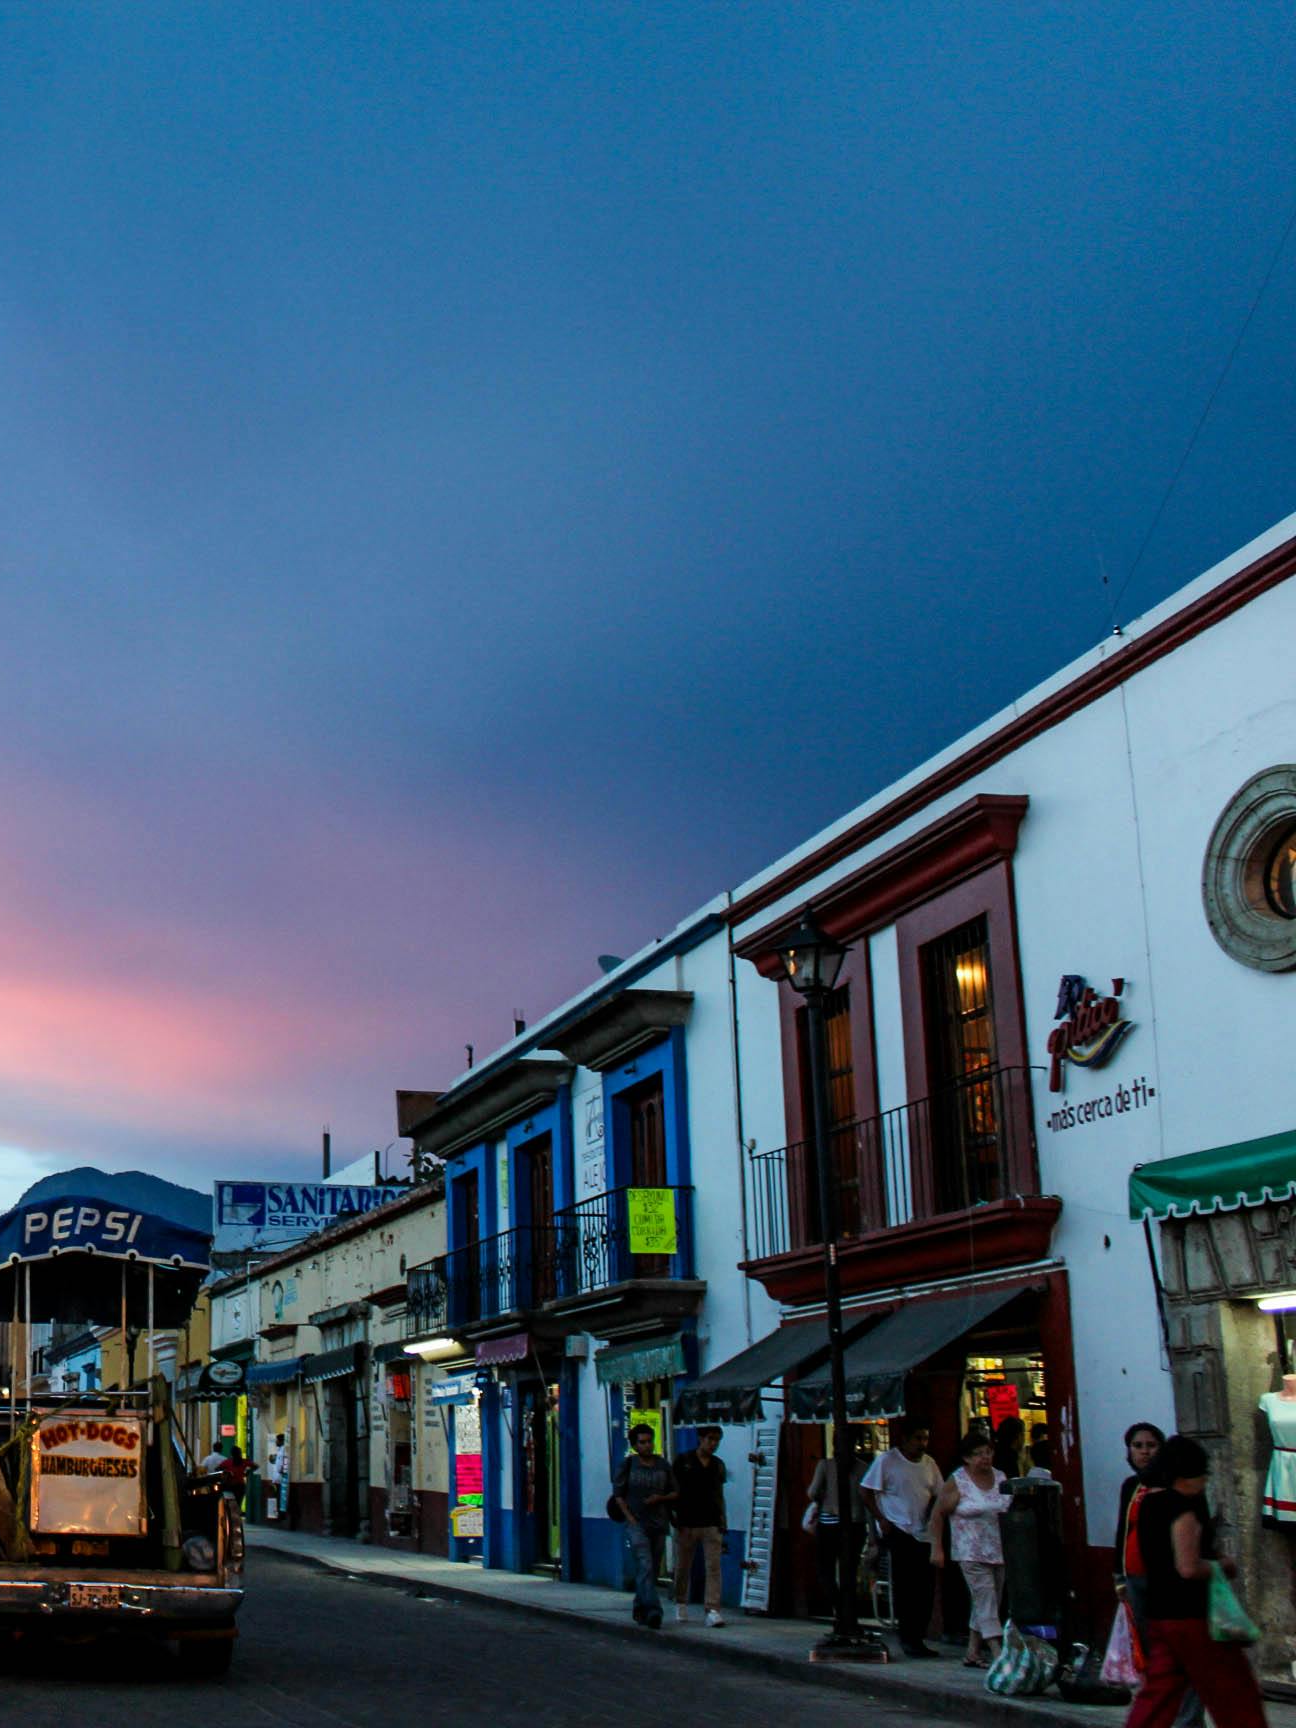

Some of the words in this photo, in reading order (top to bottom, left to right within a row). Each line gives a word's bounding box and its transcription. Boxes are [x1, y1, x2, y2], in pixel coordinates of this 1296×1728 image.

[1076, 1095, 1112, 1125] cerca
[1114, 1083, 1131, 1113] de
[24, 1206, 144, 1244] PEPSI
[40, 1421, 139, 1450] HOT-DOGS
